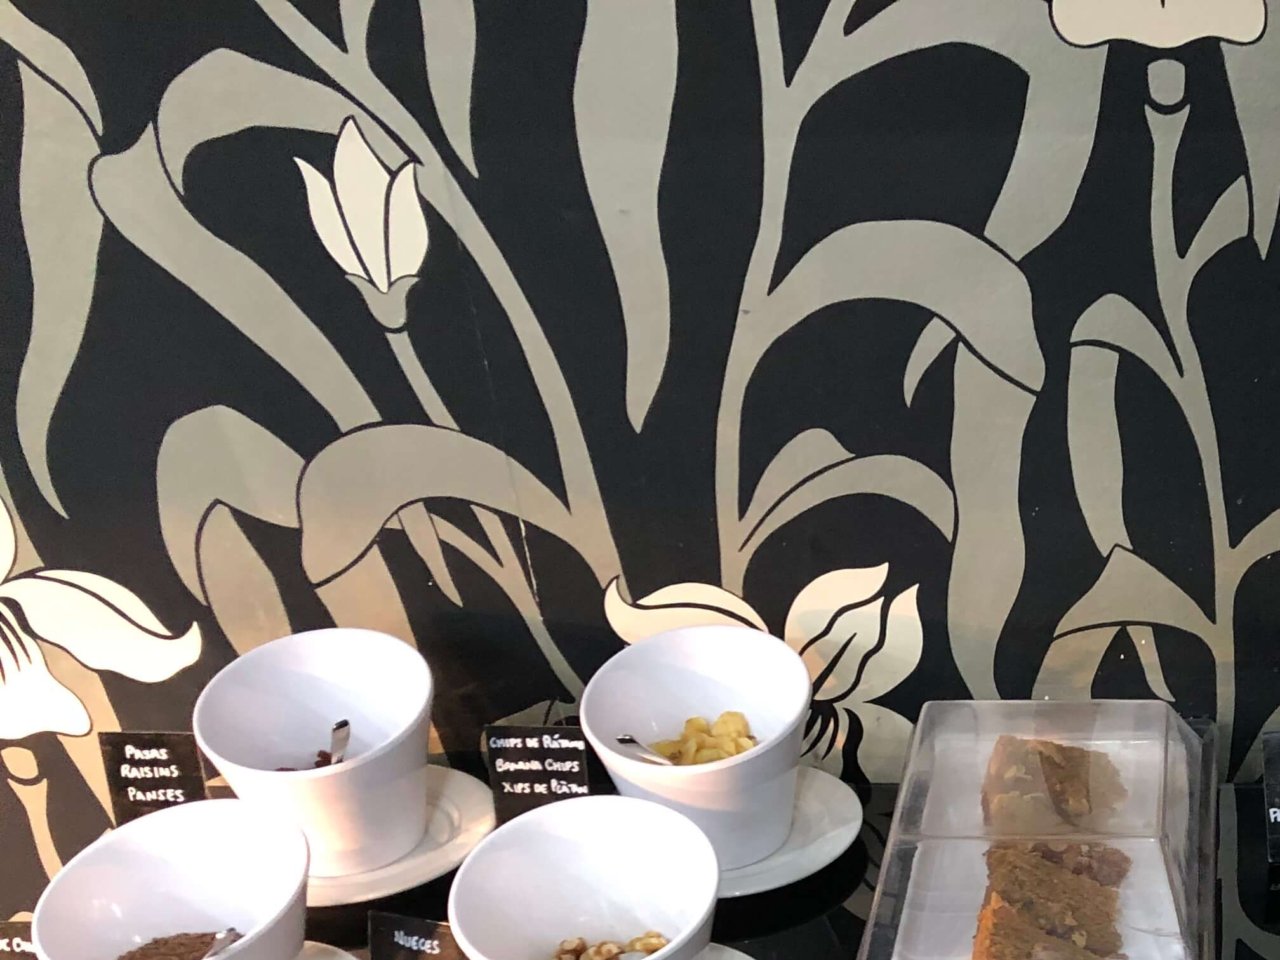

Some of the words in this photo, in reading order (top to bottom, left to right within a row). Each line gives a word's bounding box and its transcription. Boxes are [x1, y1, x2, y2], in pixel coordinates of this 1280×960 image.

[489, 737, 522, 748] CHIPS
[525, 737, 540, 748] DE
[124, 744, 168, 760] PASAS
[120, 764, 179, 779] RAISINS
[495, 758, 543, 772] BANANA
[544, 758, 580, 772] CHIPS
[127, 786, 185, 802] PANSES
[501, 781, 531, 793] XIPS
[533, 783, 548, 794] DE
[393, 930, 441, 955] NUECES
